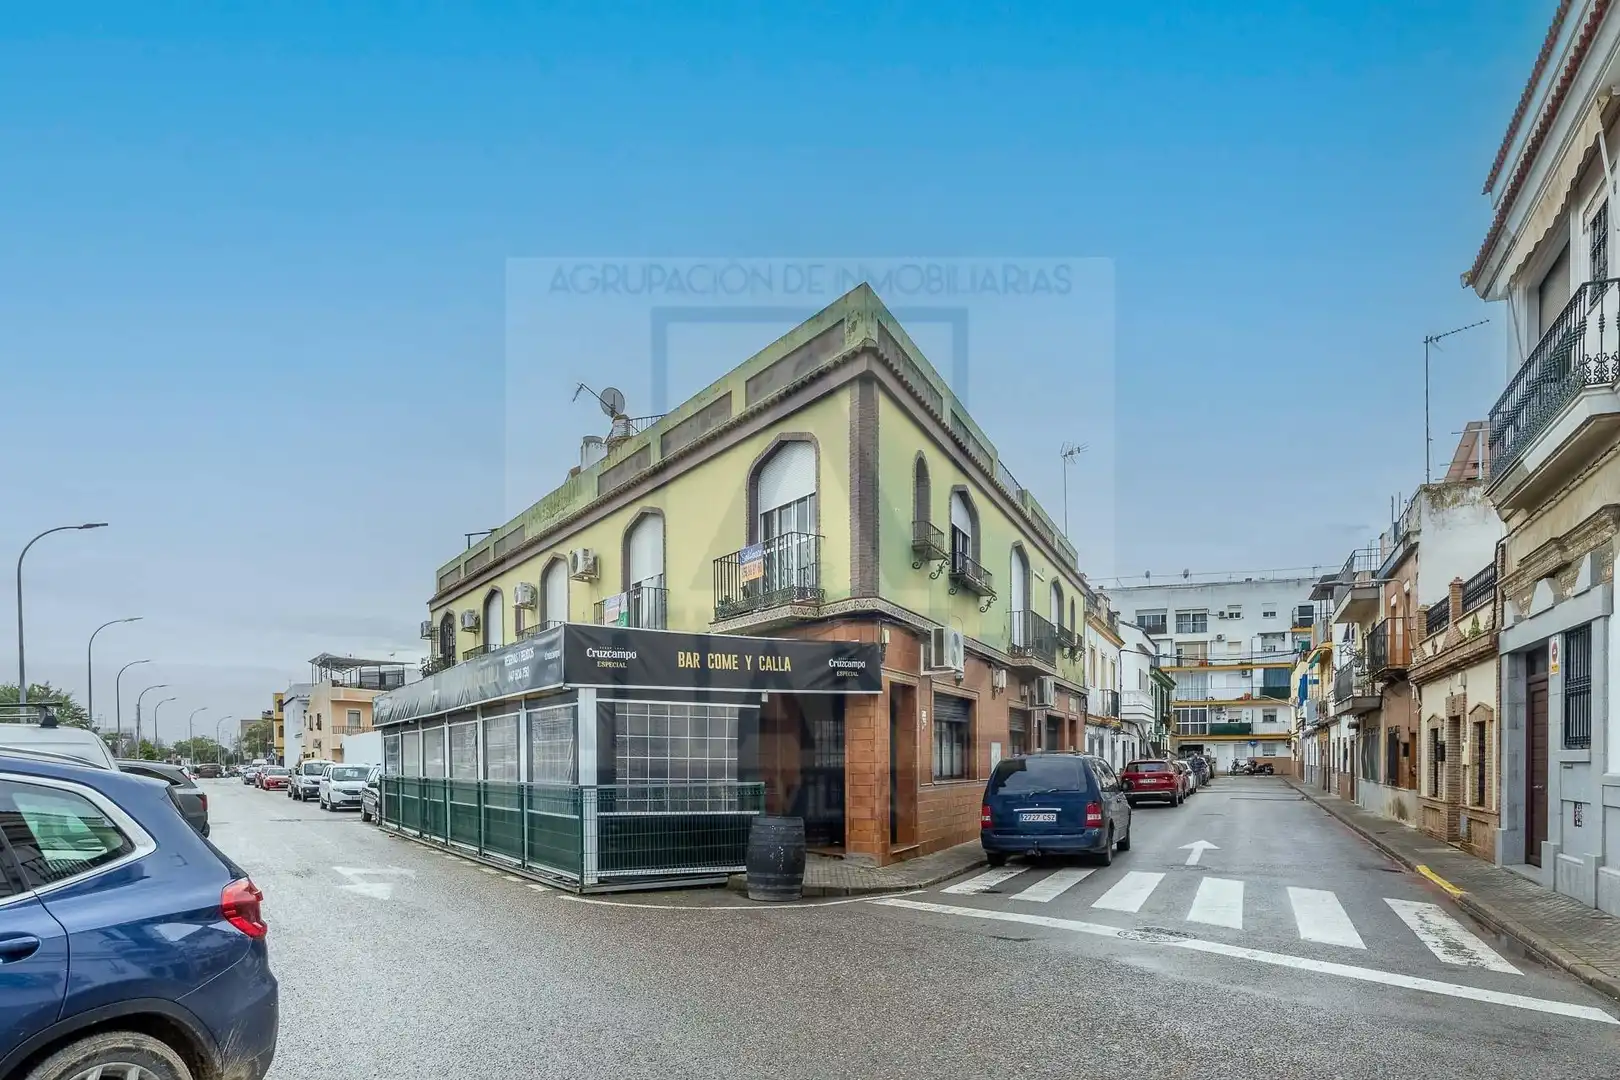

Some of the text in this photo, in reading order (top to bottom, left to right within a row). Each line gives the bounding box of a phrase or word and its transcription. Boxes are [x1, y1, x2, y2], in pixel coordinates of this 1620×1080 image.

[586, 647, 637, 660] Cruzcampo
[677, 651, 792, 672] BAR COME Y CALLA
[828, 658, 866, 669] Cruzcampo
